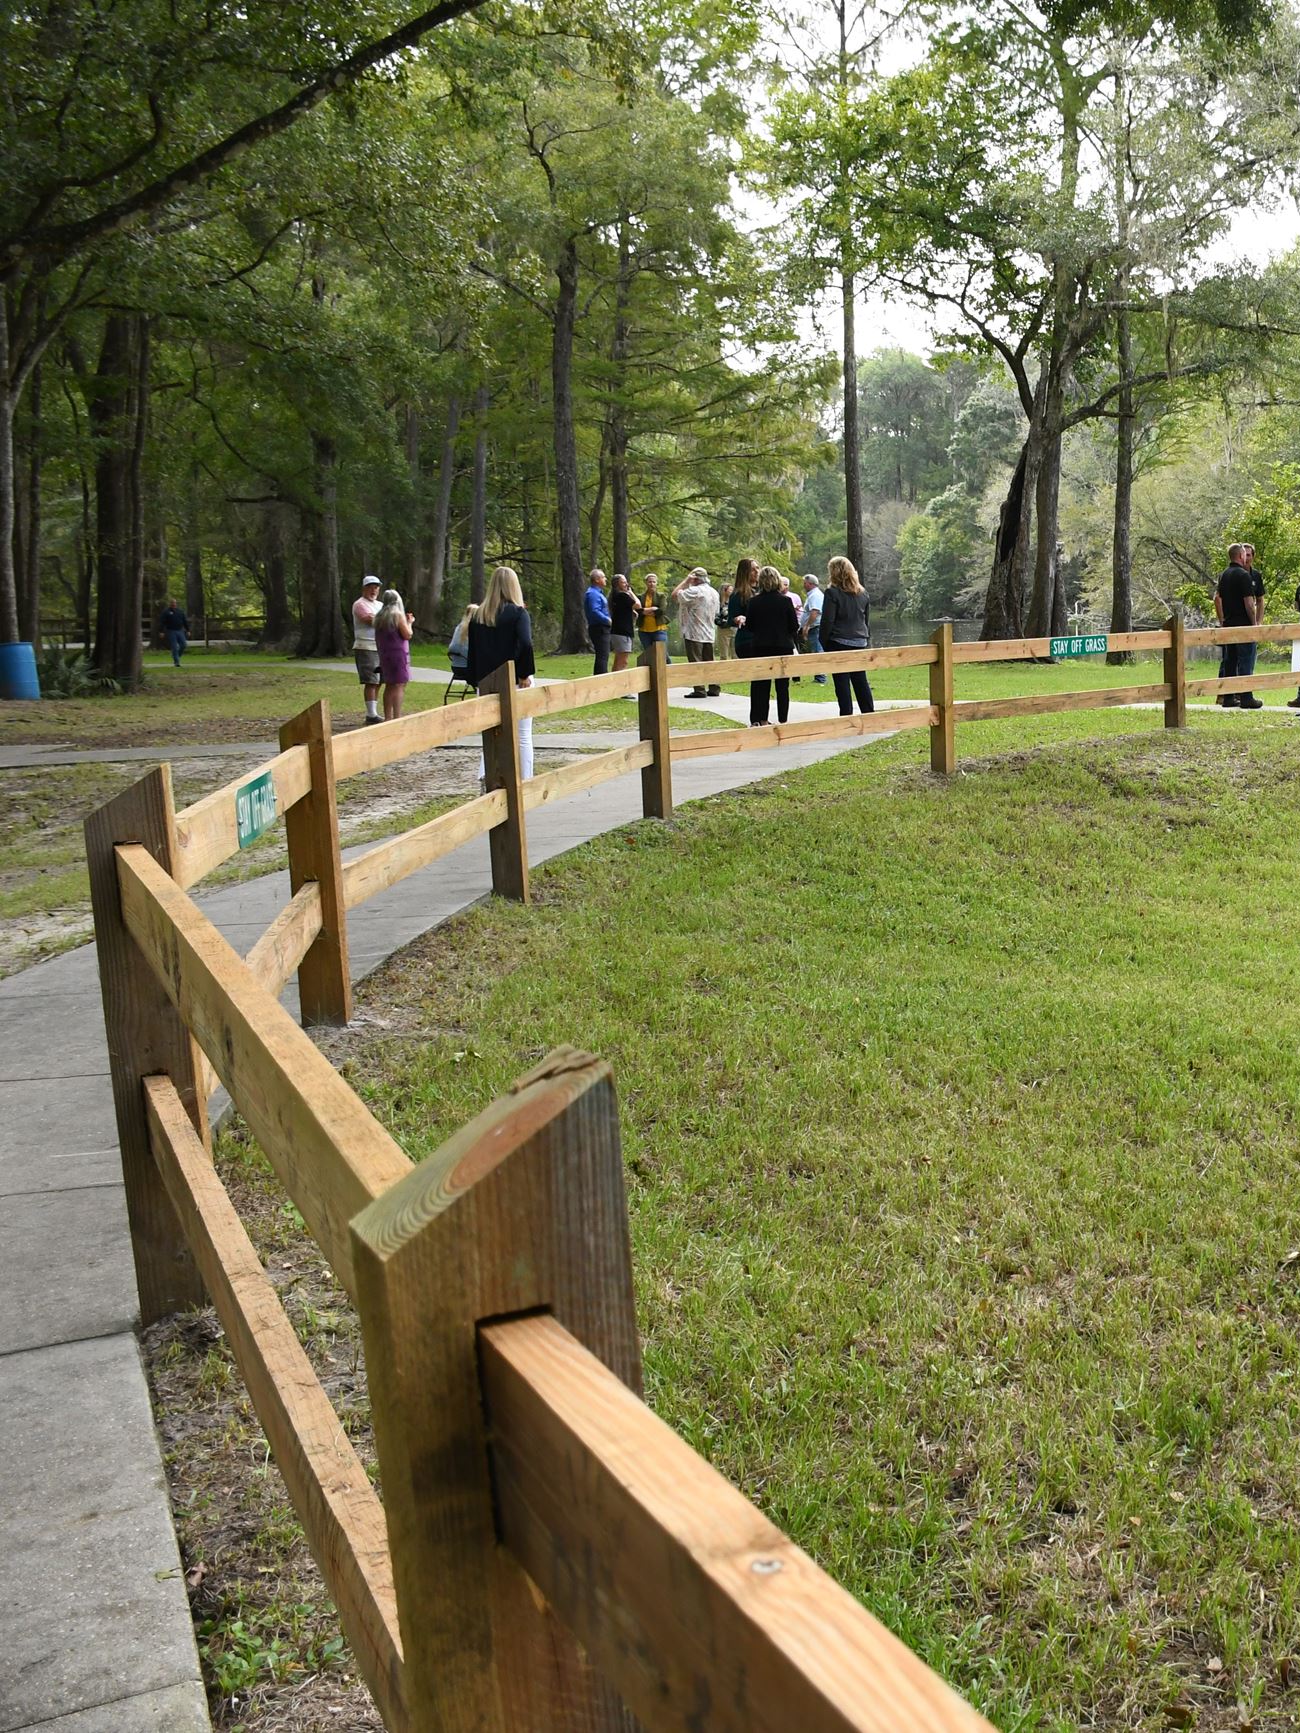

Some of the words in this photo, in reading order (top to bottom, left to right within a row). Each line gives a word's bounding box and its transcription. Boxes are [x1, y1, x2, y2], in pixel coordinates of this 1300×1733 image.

[1053, 640, 1069, 655] STAY
[1071, 639, 1083, 653] OFF
[1085, 638, 1105, 652] GRASS
